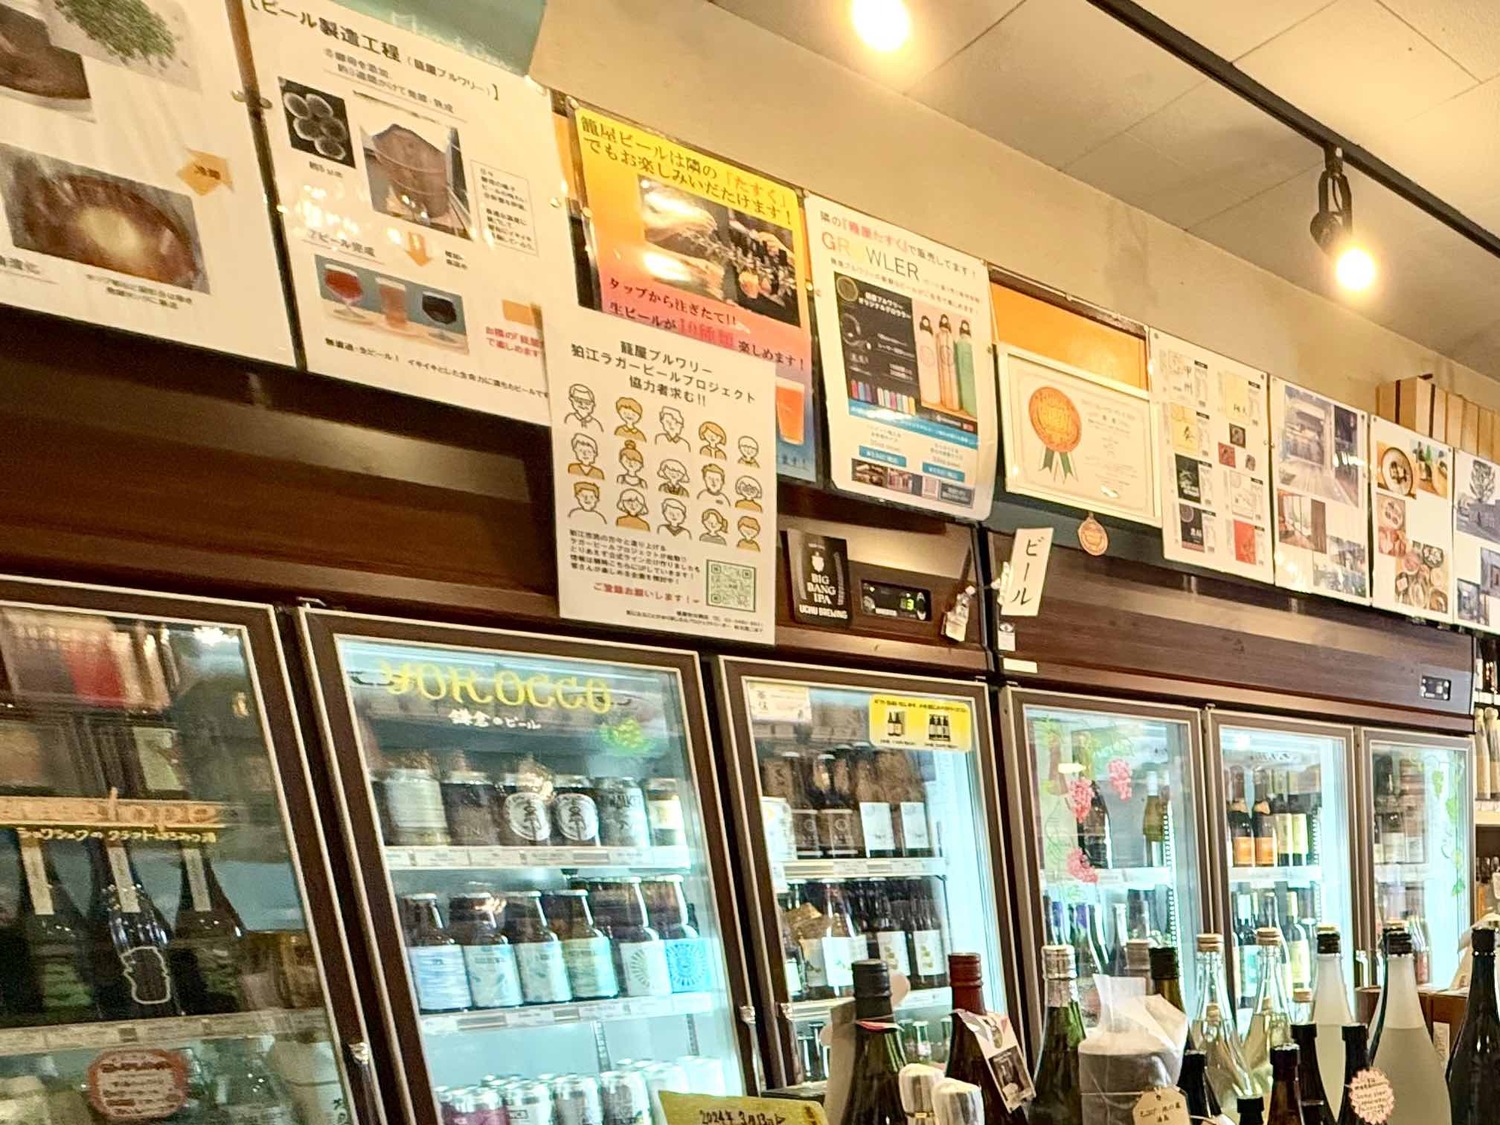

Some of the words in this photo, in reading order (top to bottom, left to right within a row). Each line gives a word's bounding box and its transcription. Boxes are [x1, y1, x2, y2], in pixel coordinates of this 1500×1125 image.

[821, 231, 920, 282] GRWLER
[811, 572, 831, 585] BIG
[1012, 534, 1045, 607] ビール
[813, 593, 833, 605] IPA
